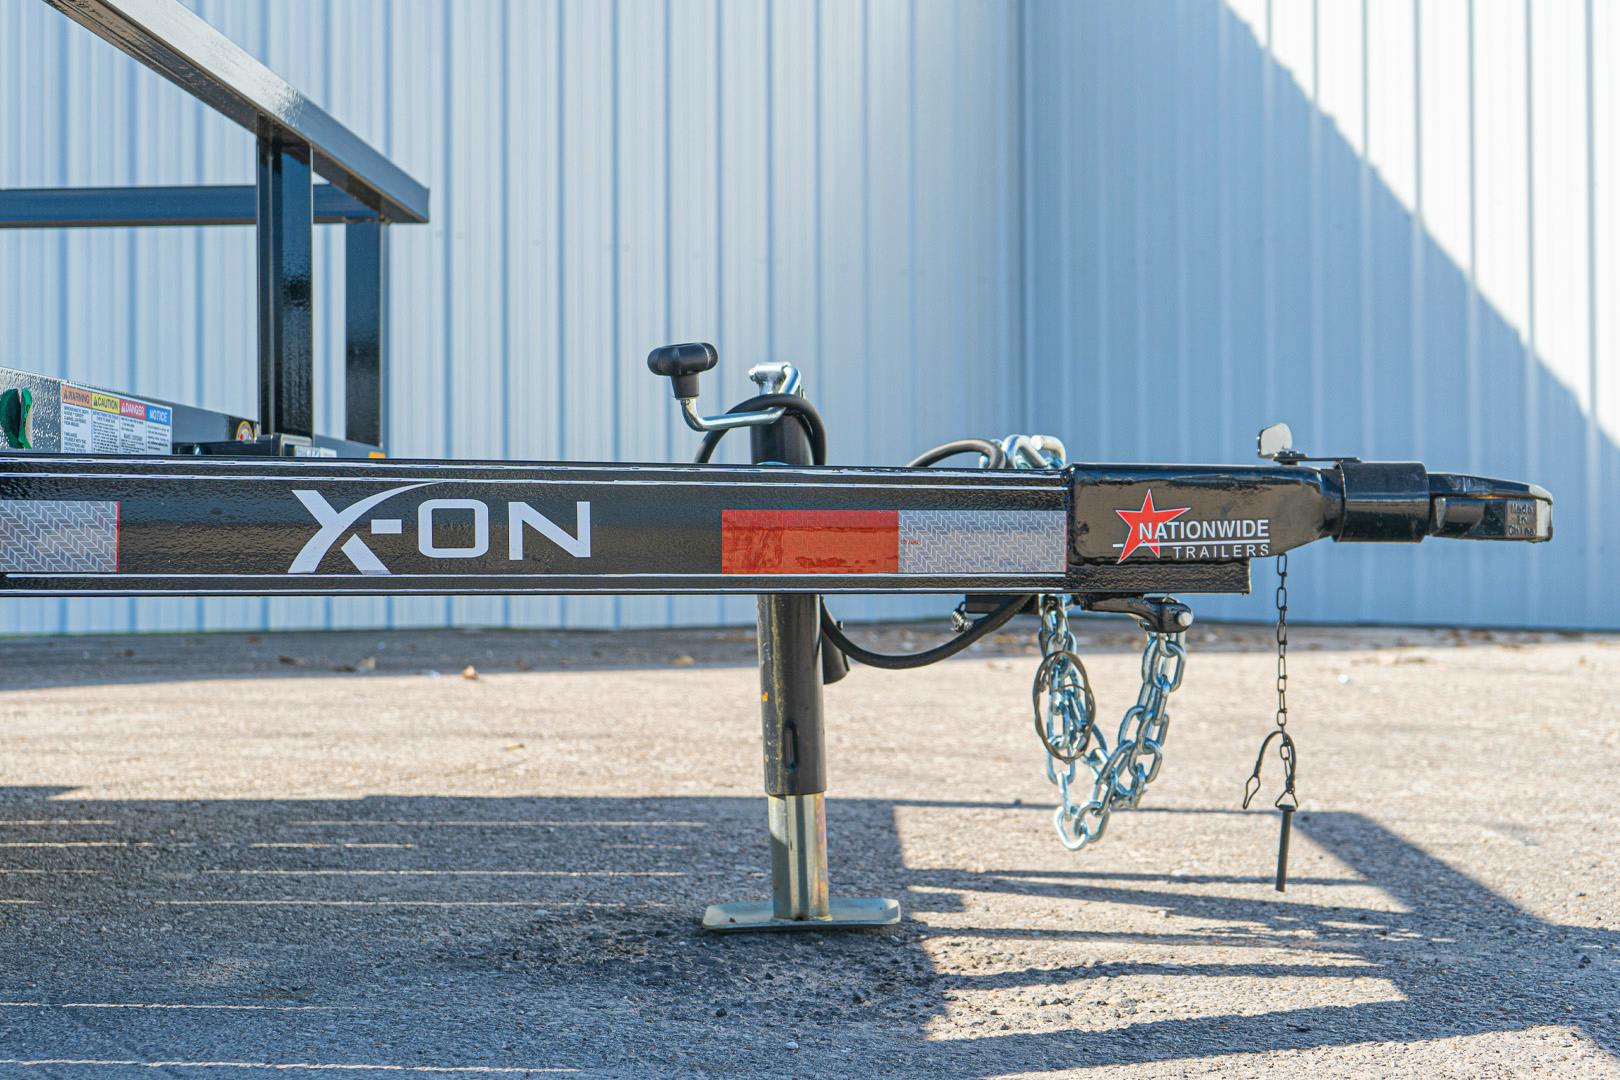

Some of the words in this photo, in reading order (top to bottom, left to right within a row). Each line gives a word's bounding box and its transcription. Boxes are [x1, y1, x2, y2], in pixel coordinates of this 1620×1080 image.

[97, 398, 118, 410] CAUTION
[125, 404, 145, 416] DANGER
[150, 409, 168, 422] NOTICE
[287, 481, 591, 575] X-ON
[1138, 519, 1269, 540] NATIONWIDE
[1173, 544, 1269, 559] TRAILERS
